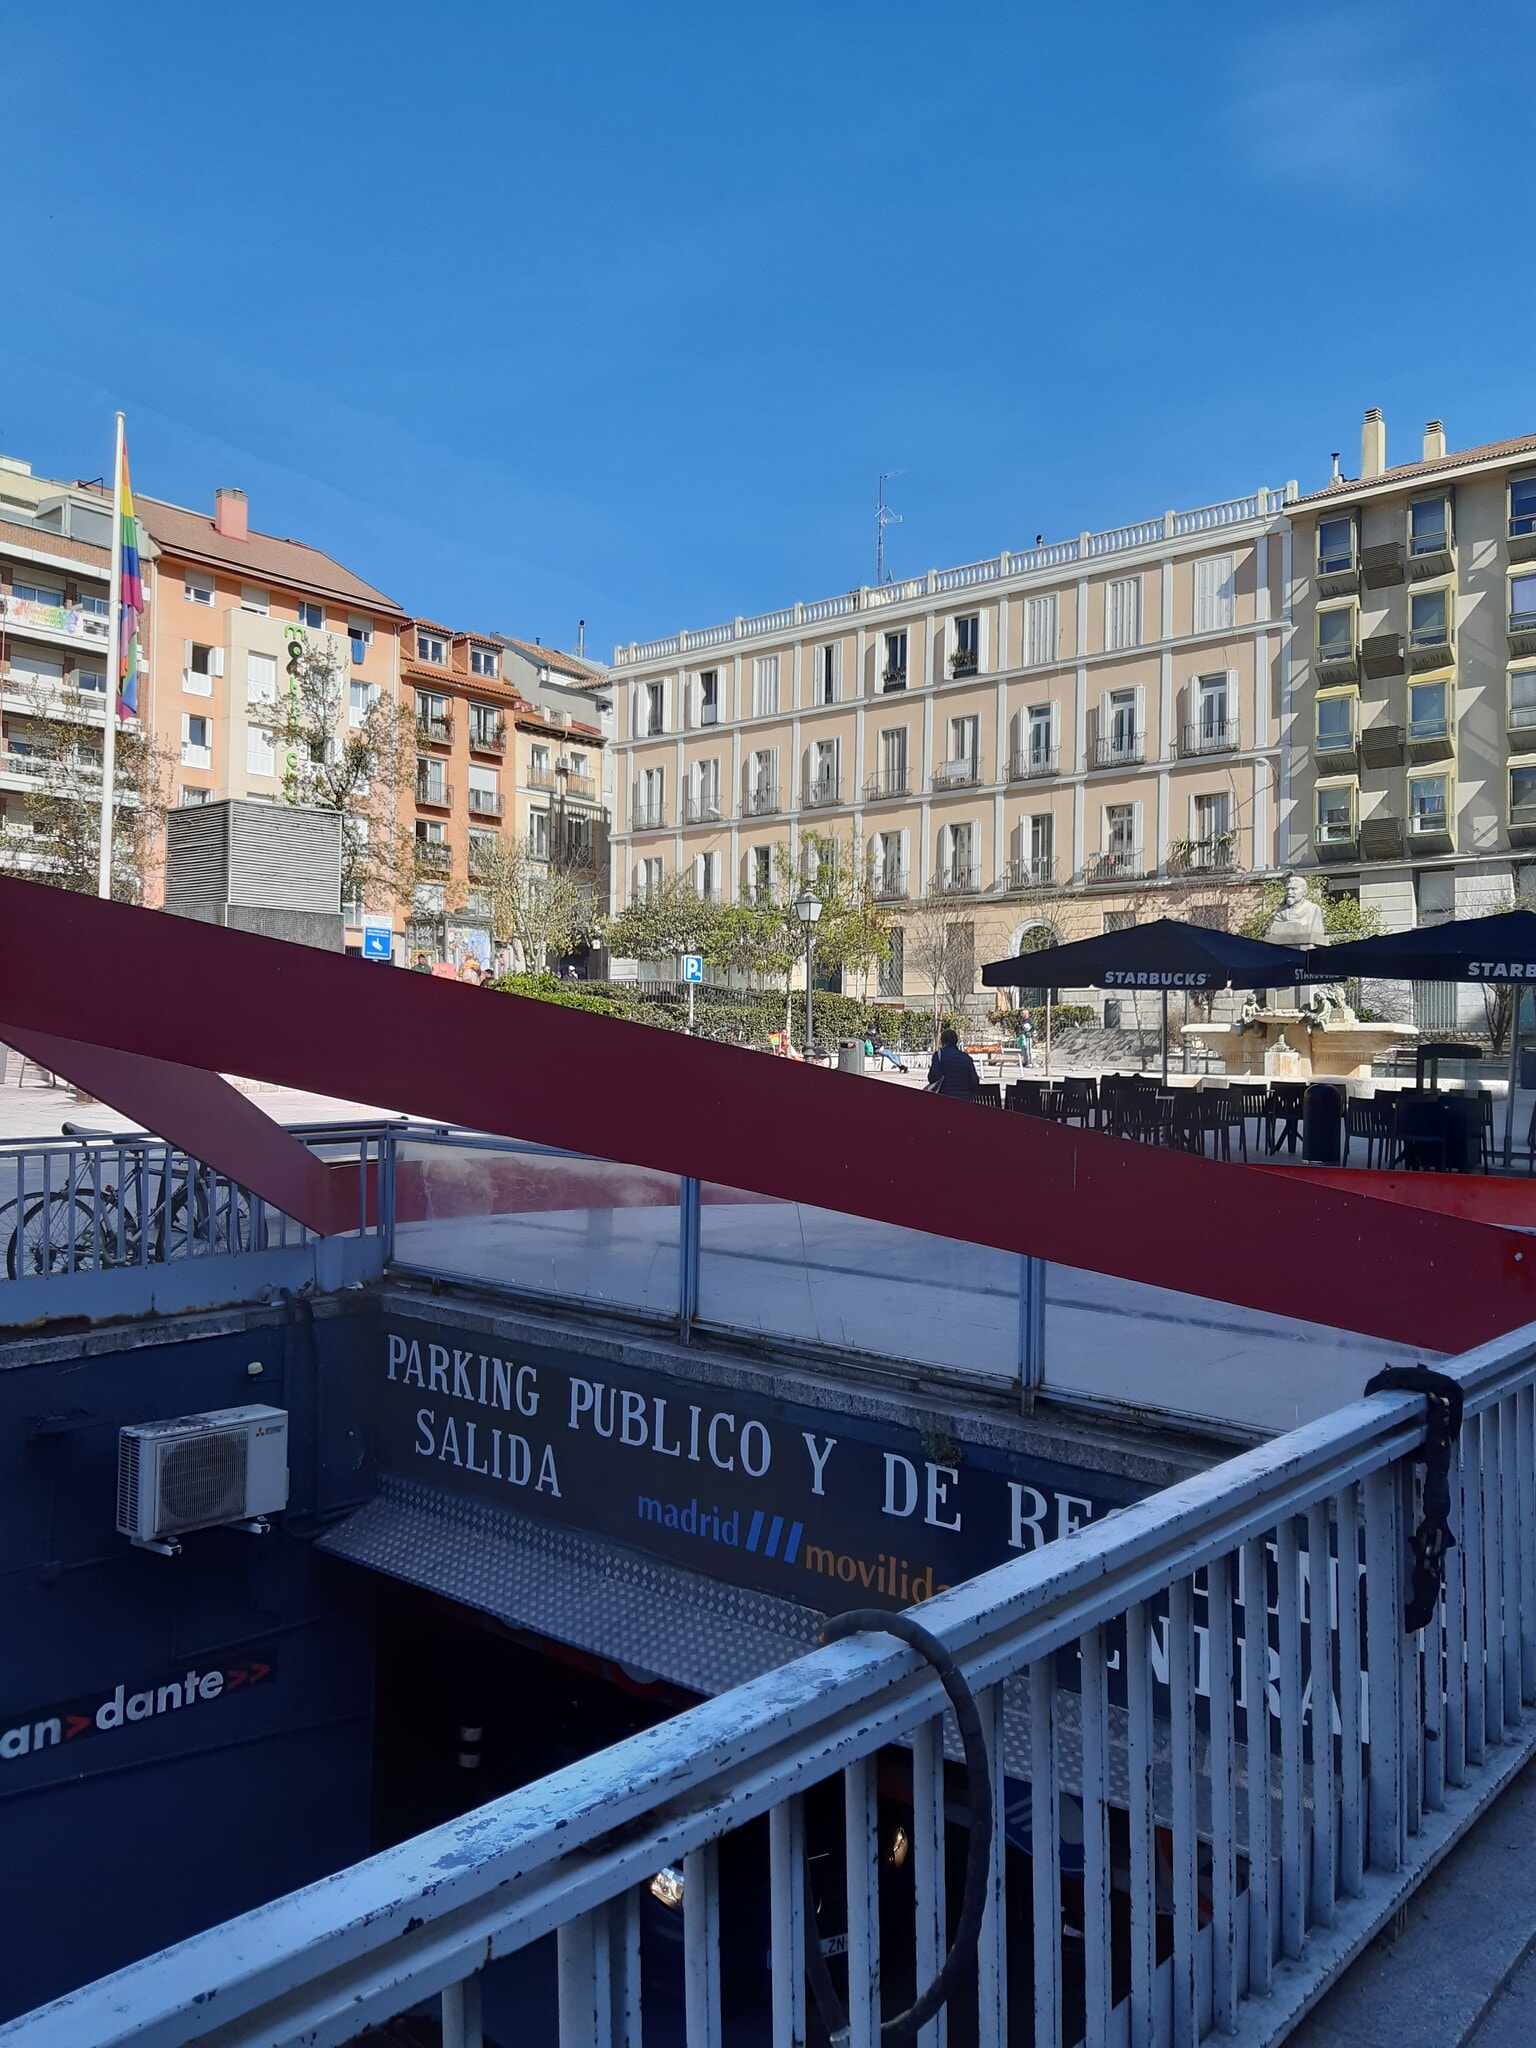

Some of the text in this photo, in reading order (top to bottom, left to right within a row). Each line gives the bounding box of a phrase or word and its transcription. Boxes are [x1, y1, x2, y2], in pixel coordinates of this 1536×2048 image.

[1104, 971, 1208, 986] STARBUCKS
[387, 1333, 962, 1532] PARKING PUBLICO Y DE
[415, 1408, 562, 1498] SALIDA
[637, 1495, 739, 1547] madrid
